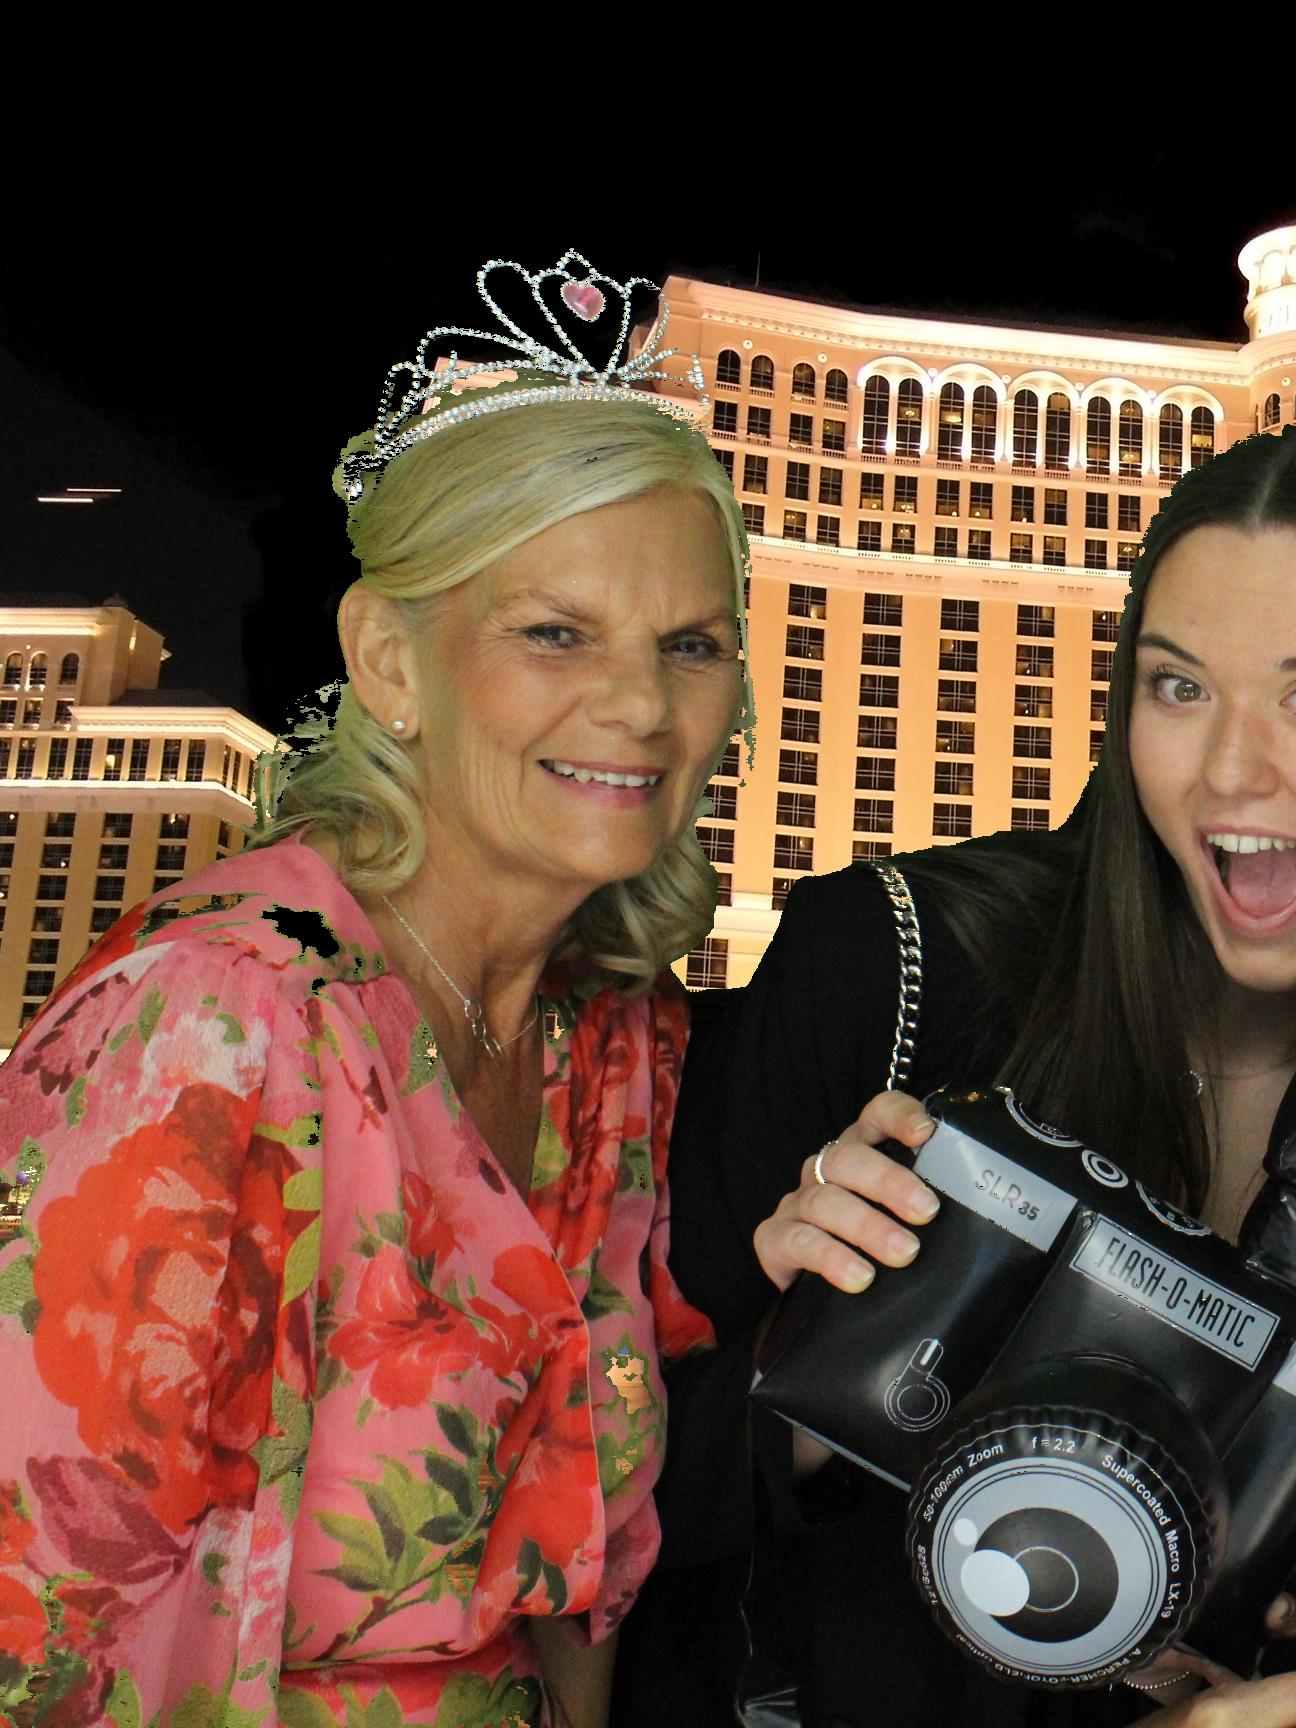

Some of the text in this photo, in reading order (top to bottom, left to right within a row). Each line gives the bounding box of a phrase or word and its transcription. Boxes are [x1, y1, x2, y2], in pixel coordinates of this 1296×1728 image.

[975, 1169, 1022, 1208] SLR
[1099, 1236, 1256, 1349] FLASH-O-MATIC
[967, 1443, 1004, 1468] Zoom
[1102, 1454, 1171, 1526] Supercoated
[1165, 1529, 1180, 1572] Macro
[1161, 1583, 1182, 1619] LX-19
